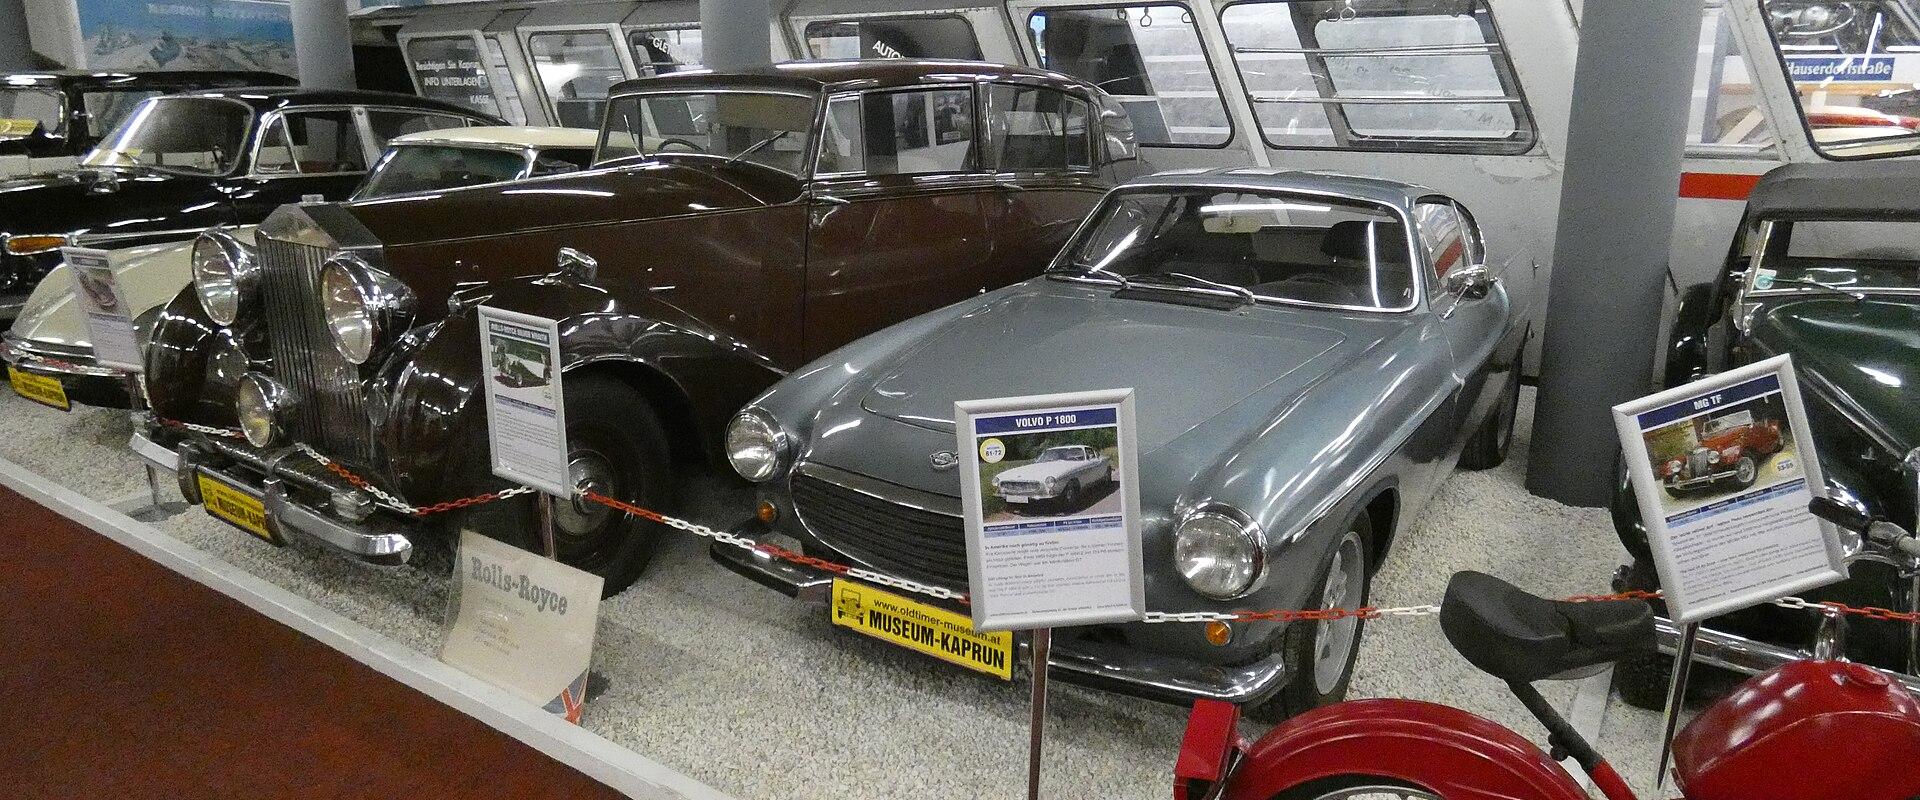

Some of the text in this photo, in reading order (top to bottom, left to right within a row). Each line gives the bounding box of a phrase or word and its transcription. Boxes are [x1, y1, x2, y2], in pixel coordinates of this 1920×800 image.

[872, 40, 906, 59] AUTO
[424, 77, 440, 86] INFO
[1693, 394, 1722, 410] MG TF
[1015, 414, 1077, 428] VOLVO P 1800
[471, 556, 568, 615] Rolls-Royce
[873, 599, 1001, 645] www.oldtimer-museum.at
[869, 609, 1005, 671] MUSEUM-KAPRUN
